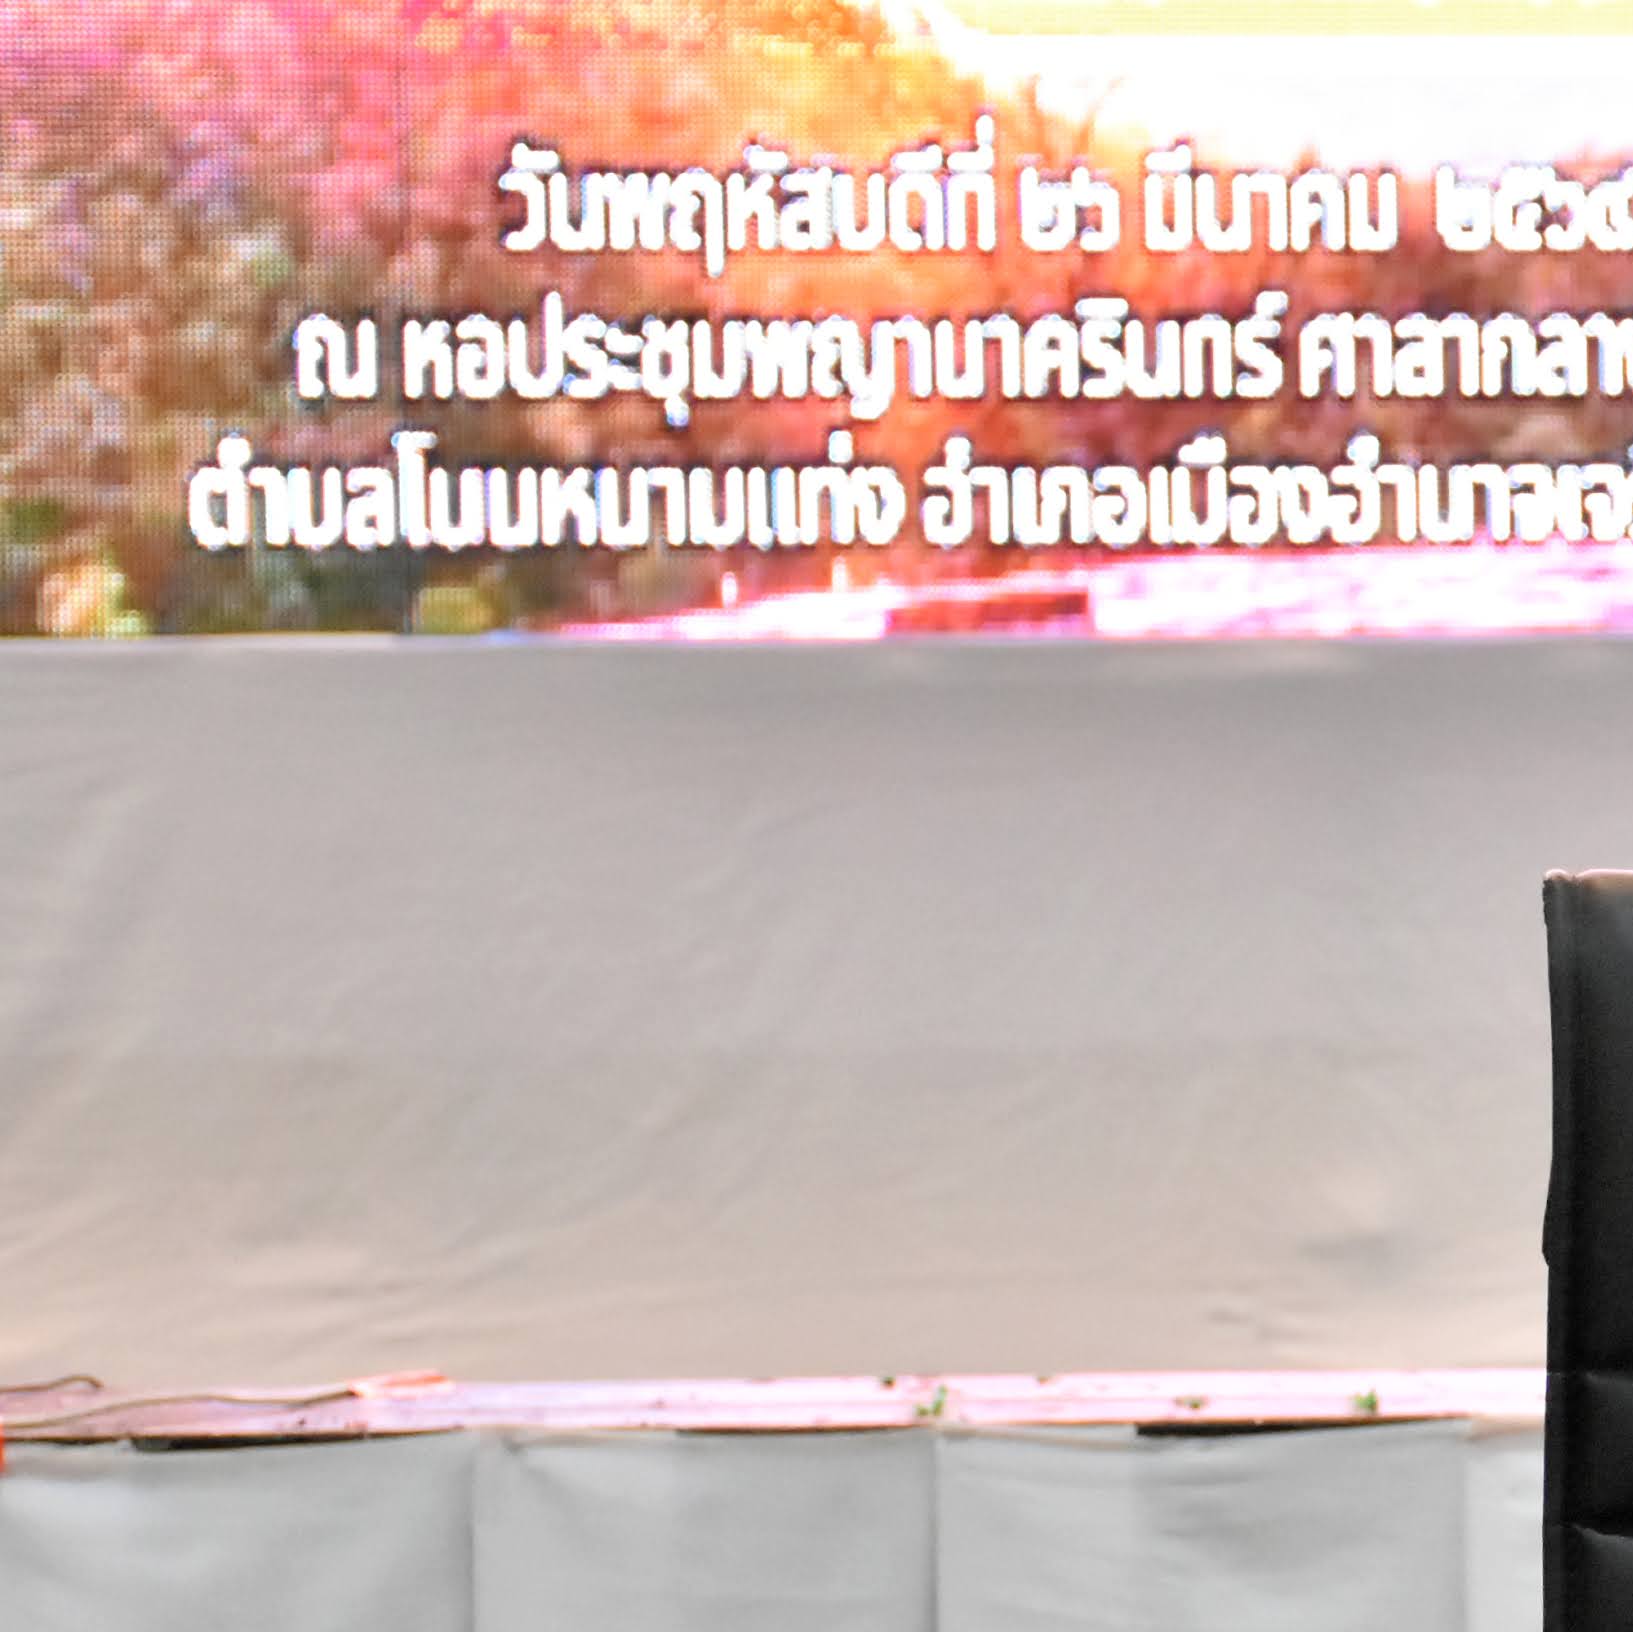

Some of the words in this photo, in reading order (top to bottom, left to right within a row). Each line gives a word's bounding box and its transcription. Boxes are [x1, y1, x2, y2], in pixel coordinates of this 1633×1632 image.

[500, 114, 997, 277] วันพฤหัสบดีที่
[1020, 165, 1121, 252] ๒๖
[1144, 143, 1398, 252] มีนาคม
[294, 312, 378, 399] ณ
[188, 430, 906, 548] ตำบลโนนหนามแท่ง
